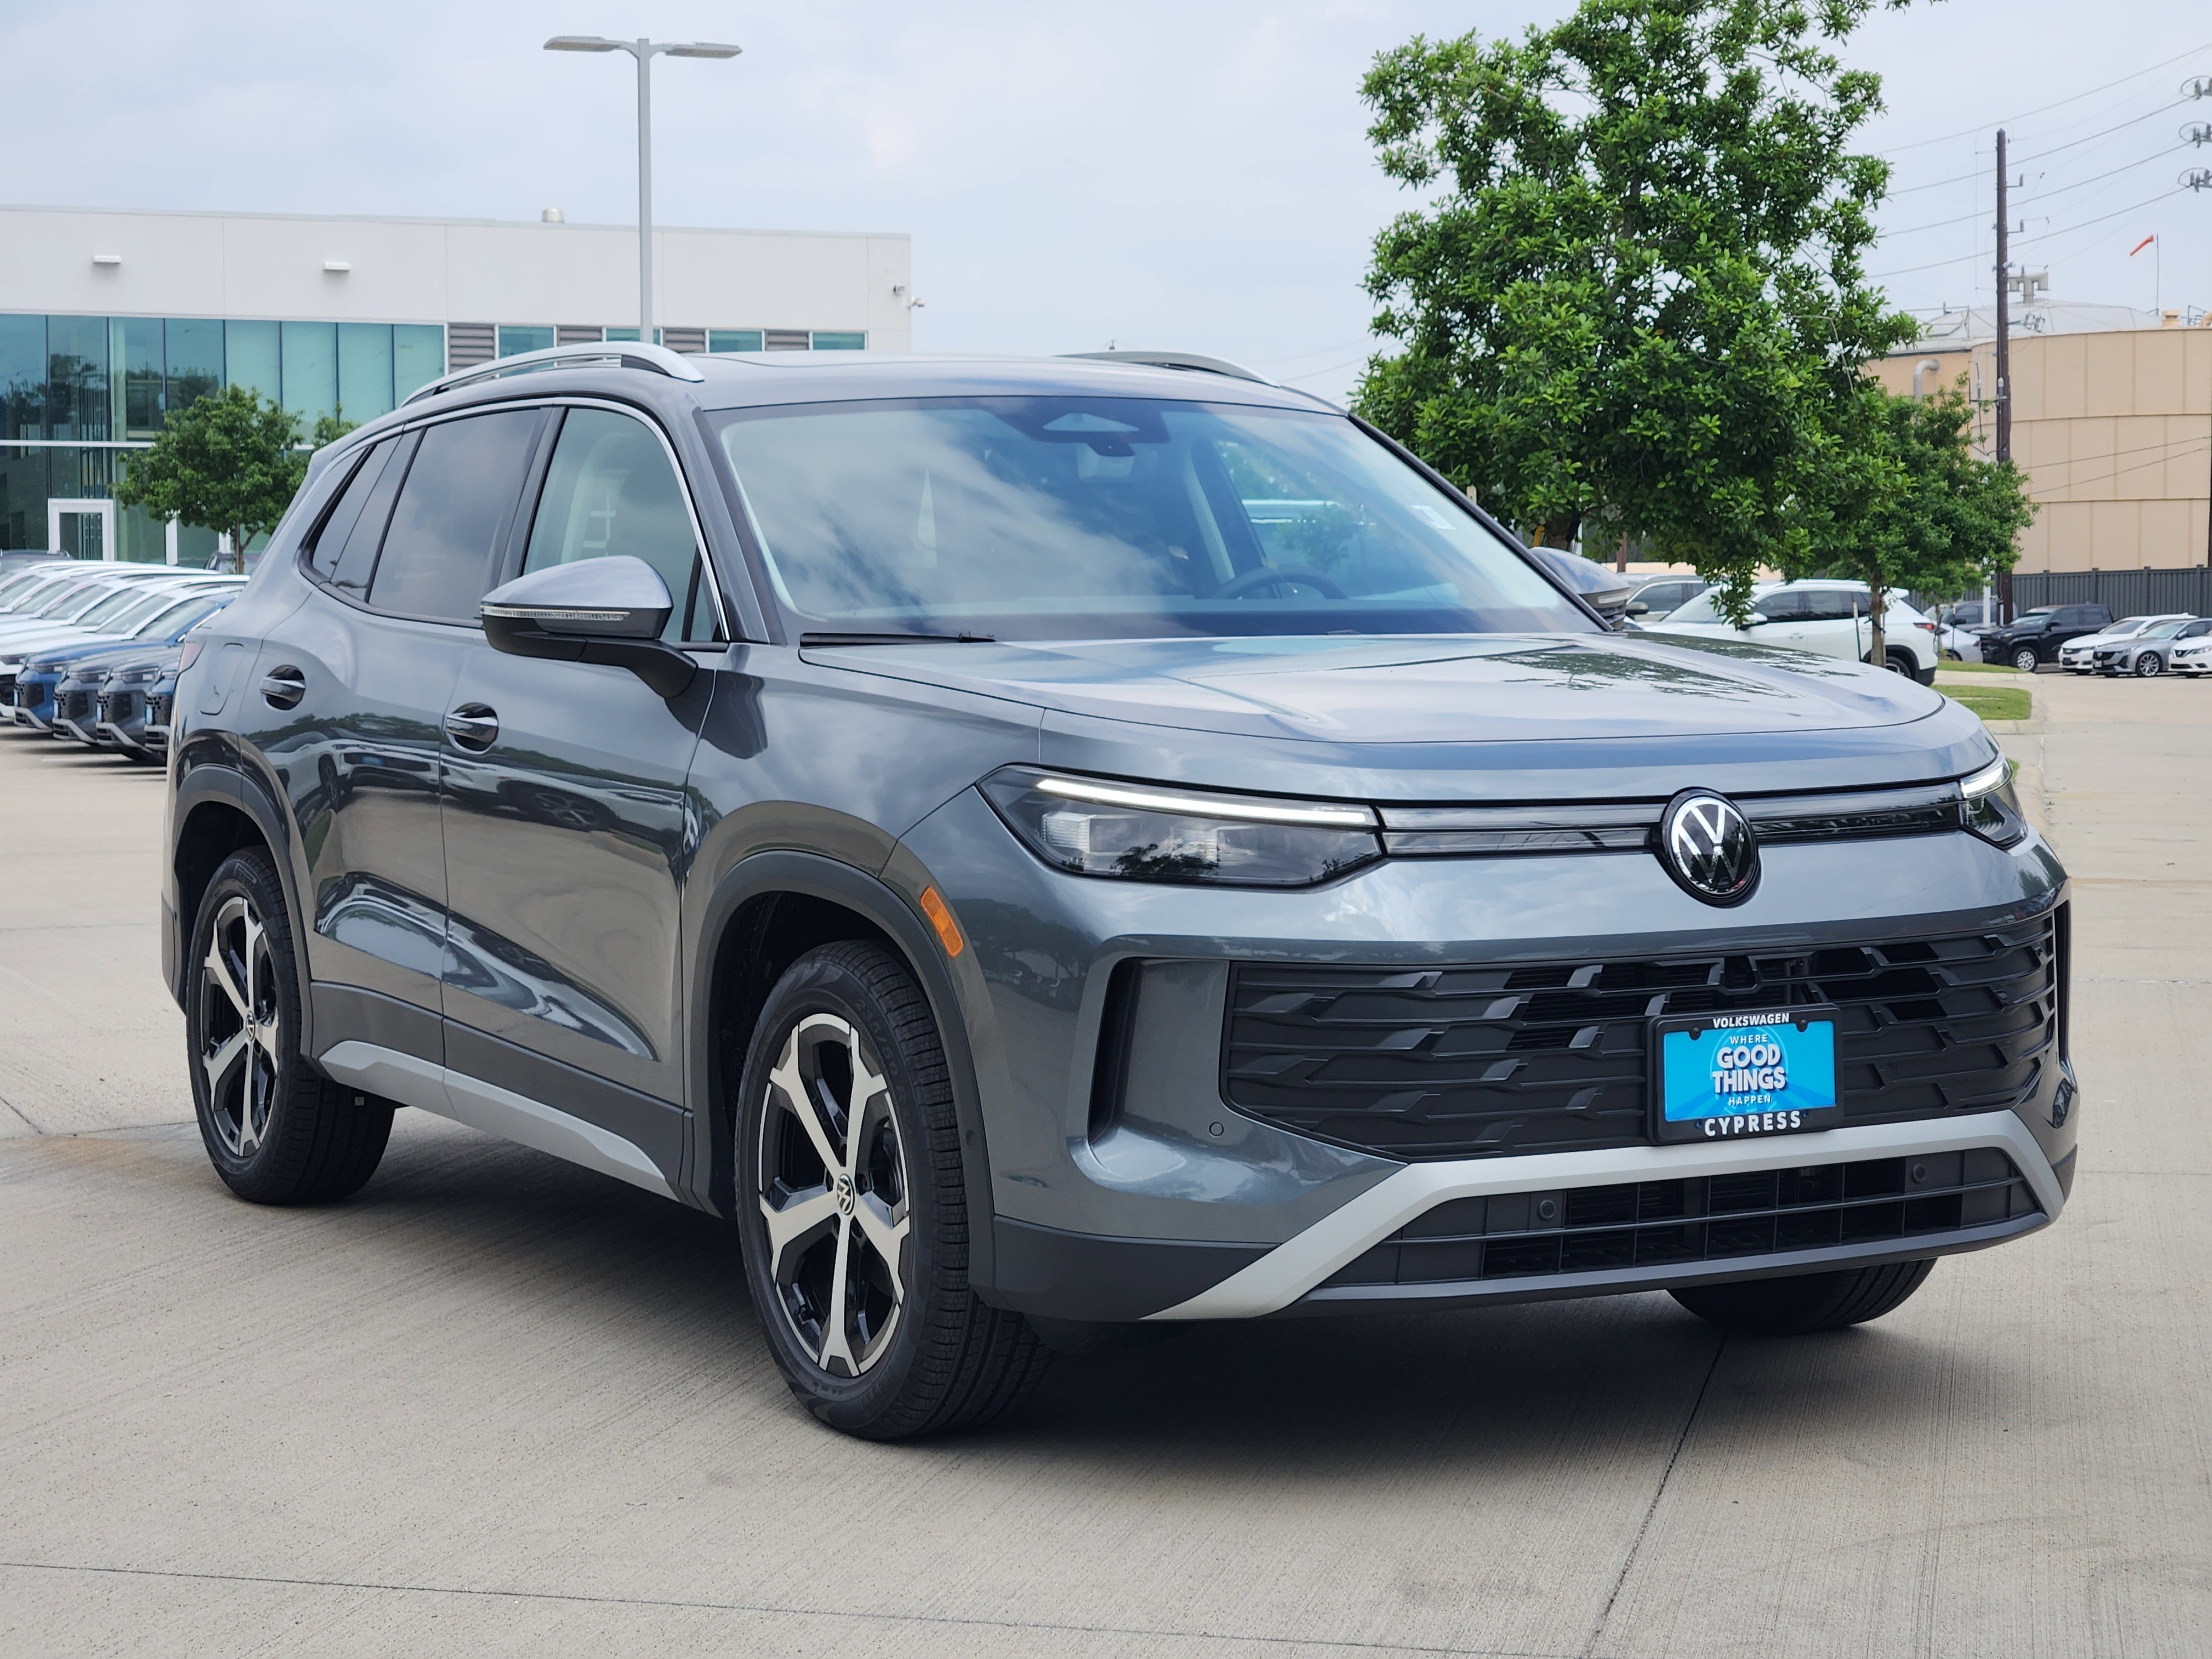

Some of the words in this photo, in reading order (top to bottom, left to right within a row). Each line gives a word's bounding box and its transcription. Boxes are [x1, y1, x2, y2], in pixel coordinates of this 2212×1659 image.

[1713, 1013, 1791, 1029] VOLKSWAGEN
[1730, 1034, 1768, 1045] WHERE
[1717, 1044, 1781, 1070] GOOD
[1712, 1066, 1787, 1093] THINGS
[1729, 1094, 1771, 1106] HAPPEN
[1704, 1110, 1802, 1137] CYPRESS
